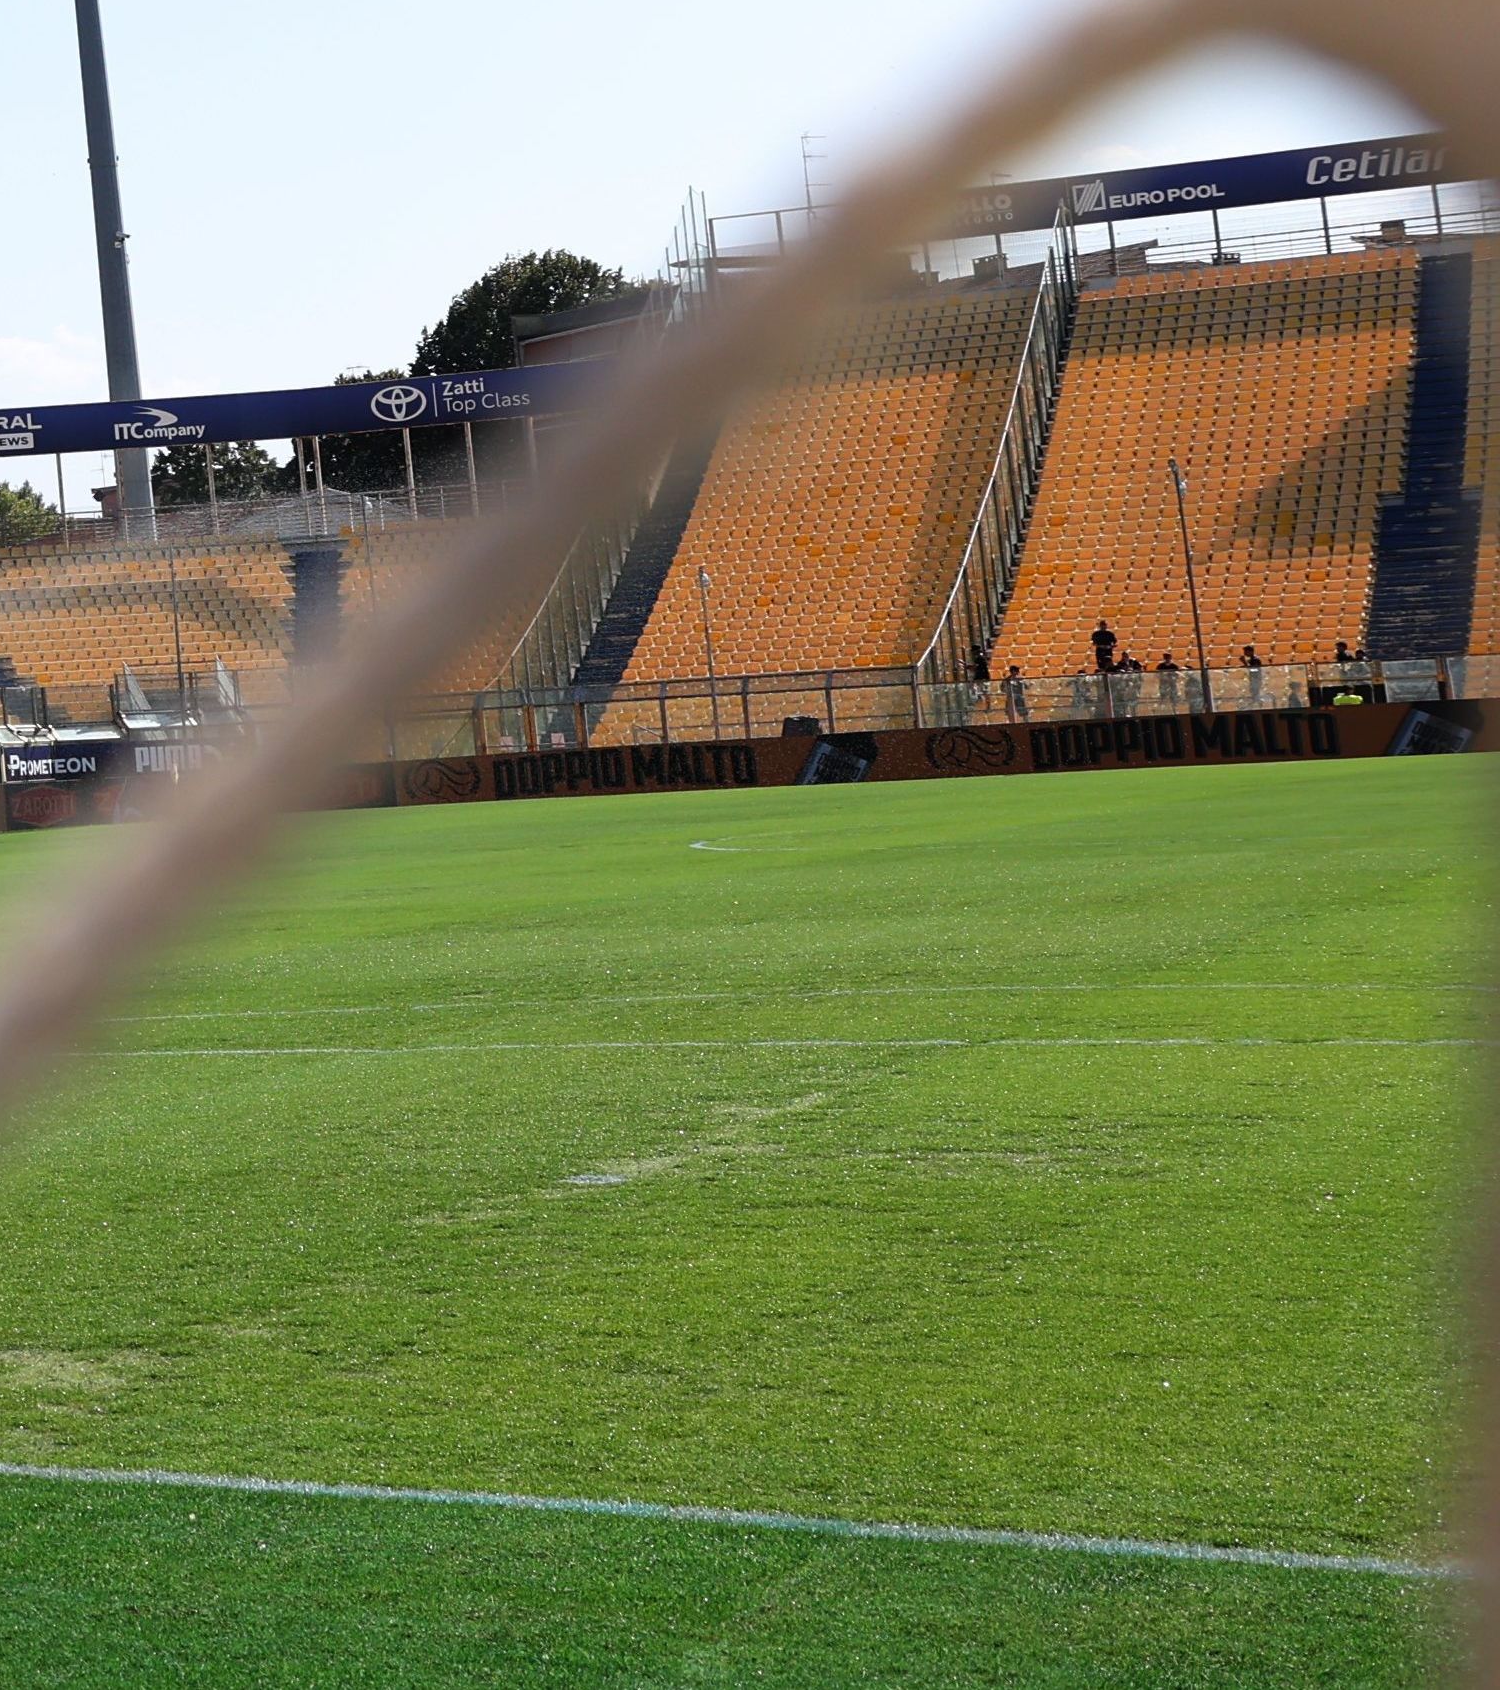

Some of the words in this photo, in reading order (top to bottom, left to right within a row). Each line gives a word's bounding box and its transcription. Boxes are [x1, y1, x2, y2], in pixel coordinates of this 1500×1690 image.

[442, 378, 484, 396] Zatti
[443, 394, 477, 414] Top
[481, 390, 531, 409] Class
[114, 422, 206, 440] ITCompany
[1030, 716, 1184, 770] DOPPIO
[1190, 712, 1336, 758] MALTO
[7, 754, 96, 777] PROMETEON
[493, 749, 626, 799] DOPPIO
[630, 745, 758, 786] MALTO
